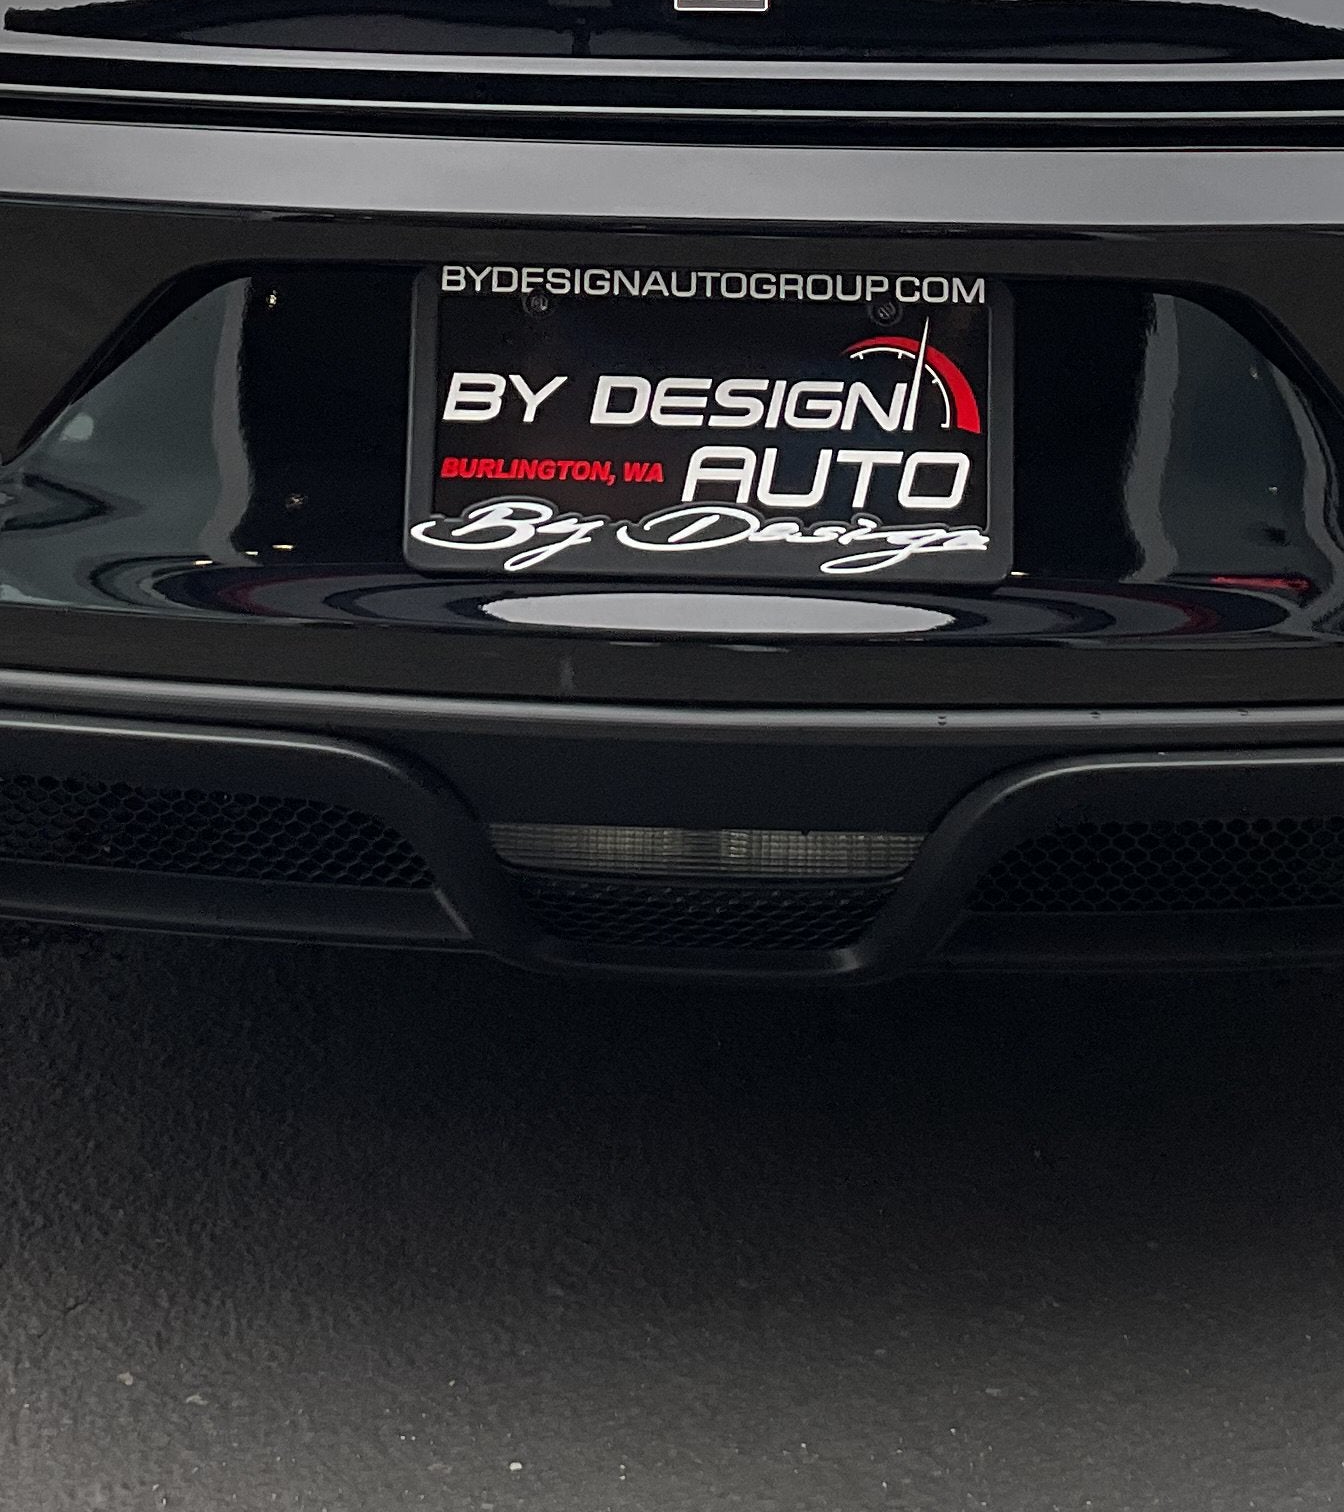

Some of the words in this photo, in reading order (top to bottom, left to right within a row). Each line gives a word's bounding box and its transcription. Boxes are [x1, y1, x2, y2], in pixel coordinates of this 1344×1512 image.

[441, 265, 985, 304] BYDESIGNAUTOGROUPCOM
[442, 372, 568, 423] BY
[589, 375, 908, 431] DESIGN
[441, 457, 616, 486] BURLINGTON,
[623, 461, 664, 483] WA
[680, 445, 971, 509] AUTO
[411, 501, 604, 572] By
